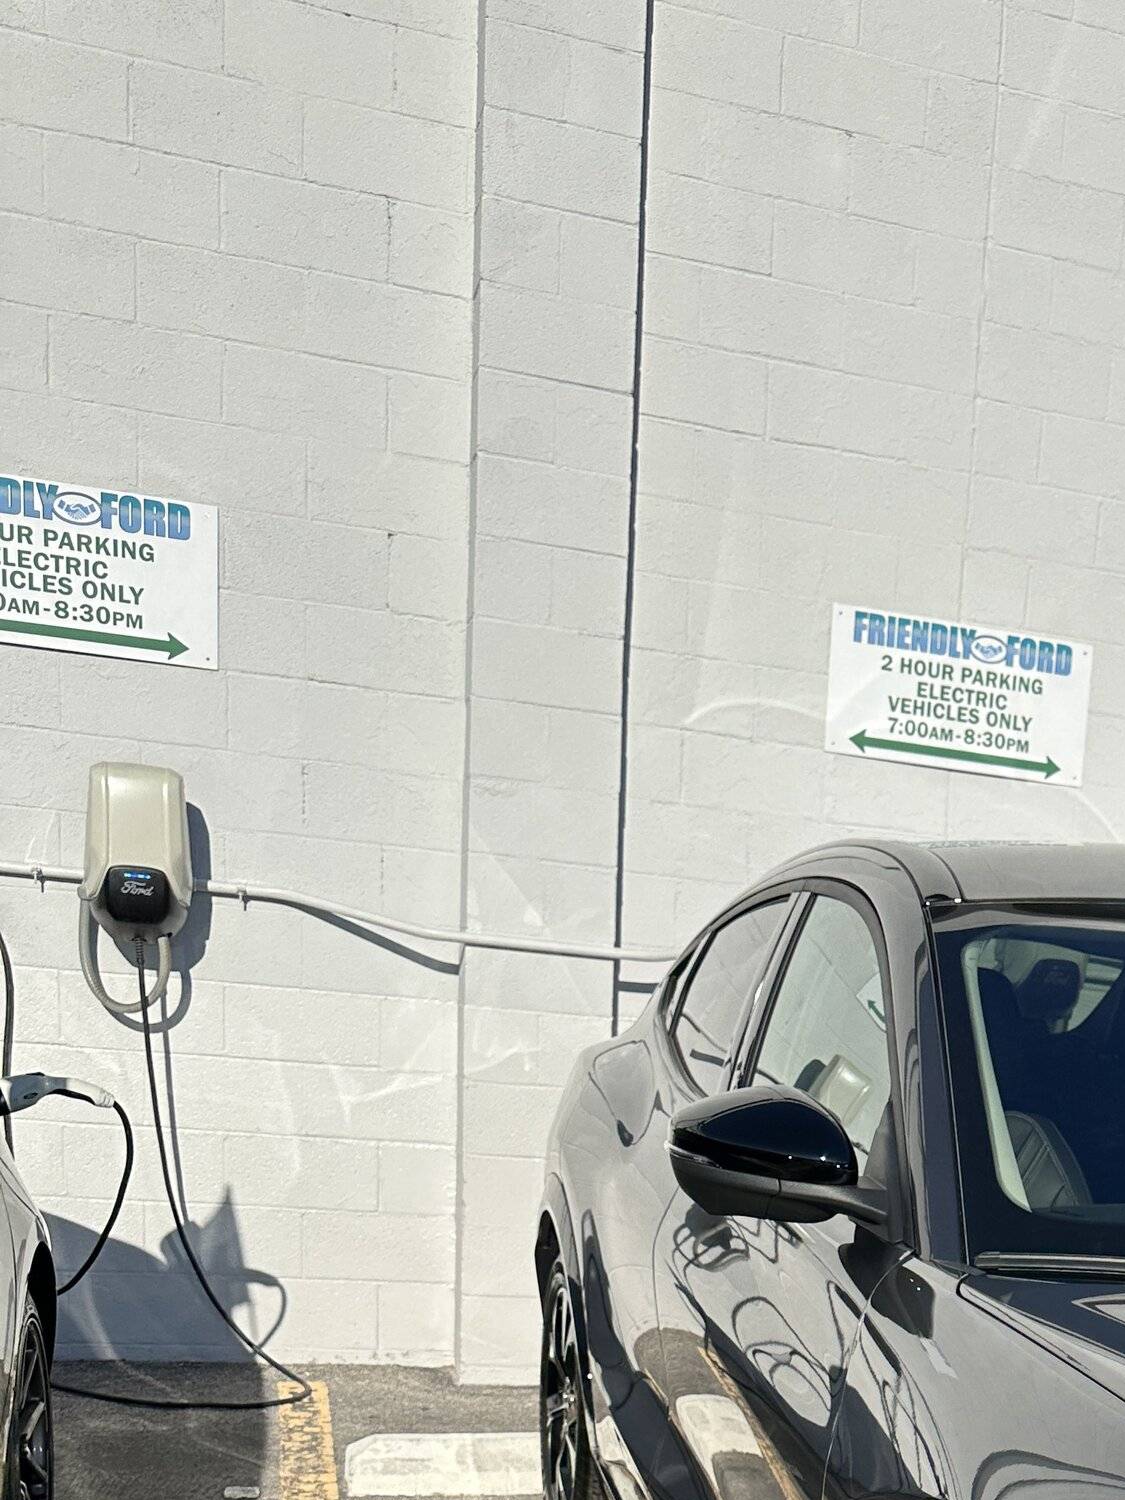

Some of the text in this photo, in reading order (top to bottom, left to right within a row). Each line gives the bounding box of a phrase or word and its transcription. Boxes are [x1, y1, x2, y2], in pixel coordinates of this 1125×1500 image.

[100, 492, 191, 541] FORD
[43, 528, 155, 562] PARKING
[0, 547, 109, 579] LECTRIC
[82, 580, 144, 605] ONLY
[853, 610, 1073, 677] FRIENDLY FORD
[881, 655, 1043, 695] 2 HOUR PARKING
[916, 682, 1008, 710] ELECTRIC
[888, 696, 1033, 733] VEHICLES ONLY
[120, 880, 155, 897] Ford
